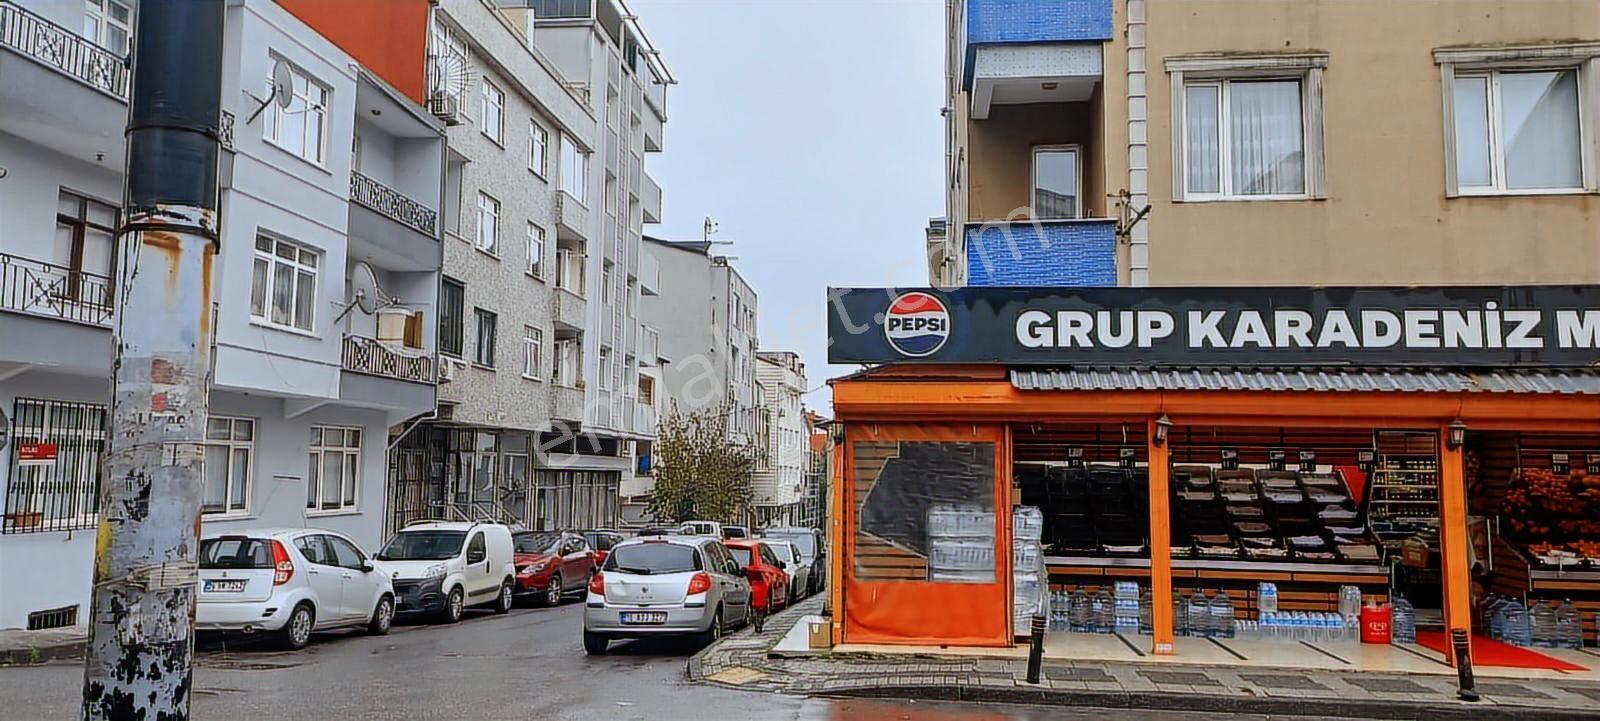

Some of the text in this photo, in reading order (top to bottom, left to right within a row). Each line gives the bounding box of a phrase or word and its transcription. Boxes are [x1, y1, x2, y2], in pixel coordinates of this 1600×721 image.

[888, 317, 946, 331] PEPSI
[1016, 311, 1174, 347] GRUP
[1188, 301, 1544, 348] KARADENİZ
